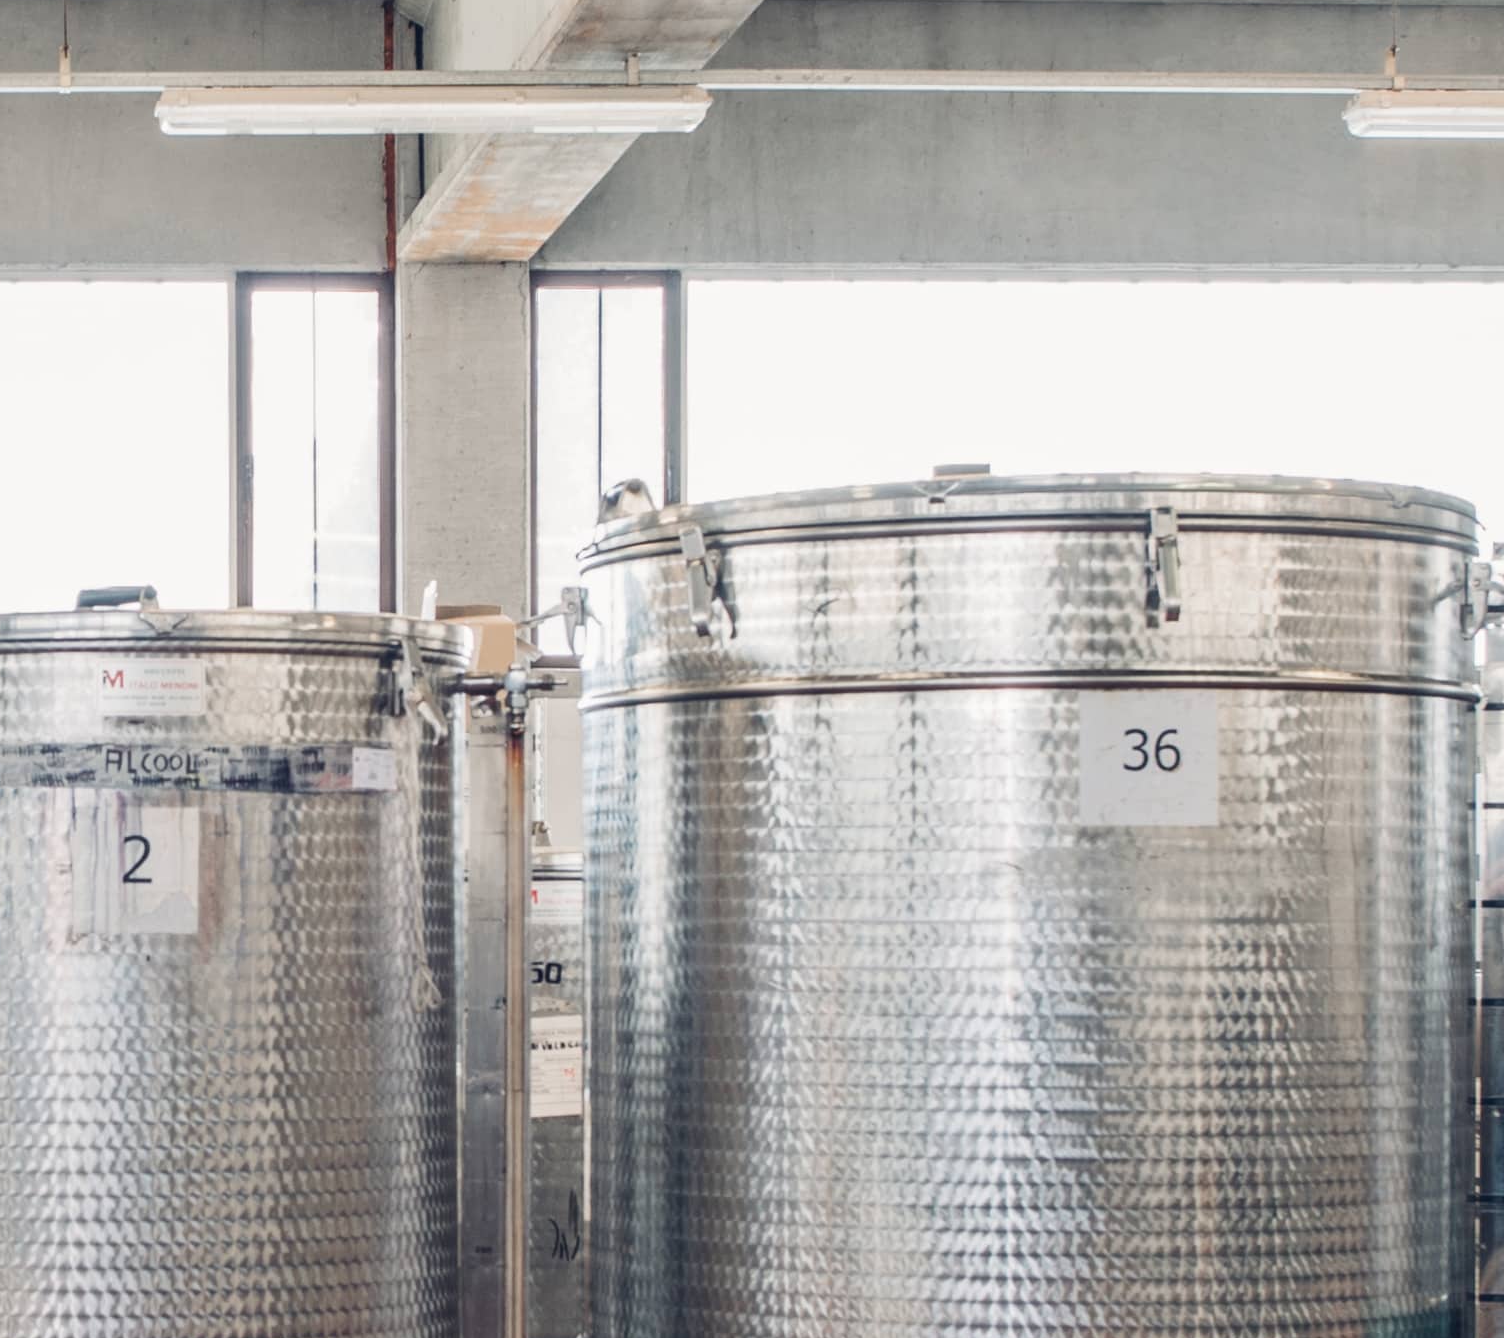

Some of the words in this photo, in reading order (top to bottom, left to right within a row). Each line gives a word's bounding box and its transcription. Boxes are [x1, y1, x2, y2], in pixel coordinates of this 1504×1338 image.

[105, 748, 199, 775] ALCOOL
[1123, 728, 1181, 771] 36
[122, 835, 152, 884] 2
